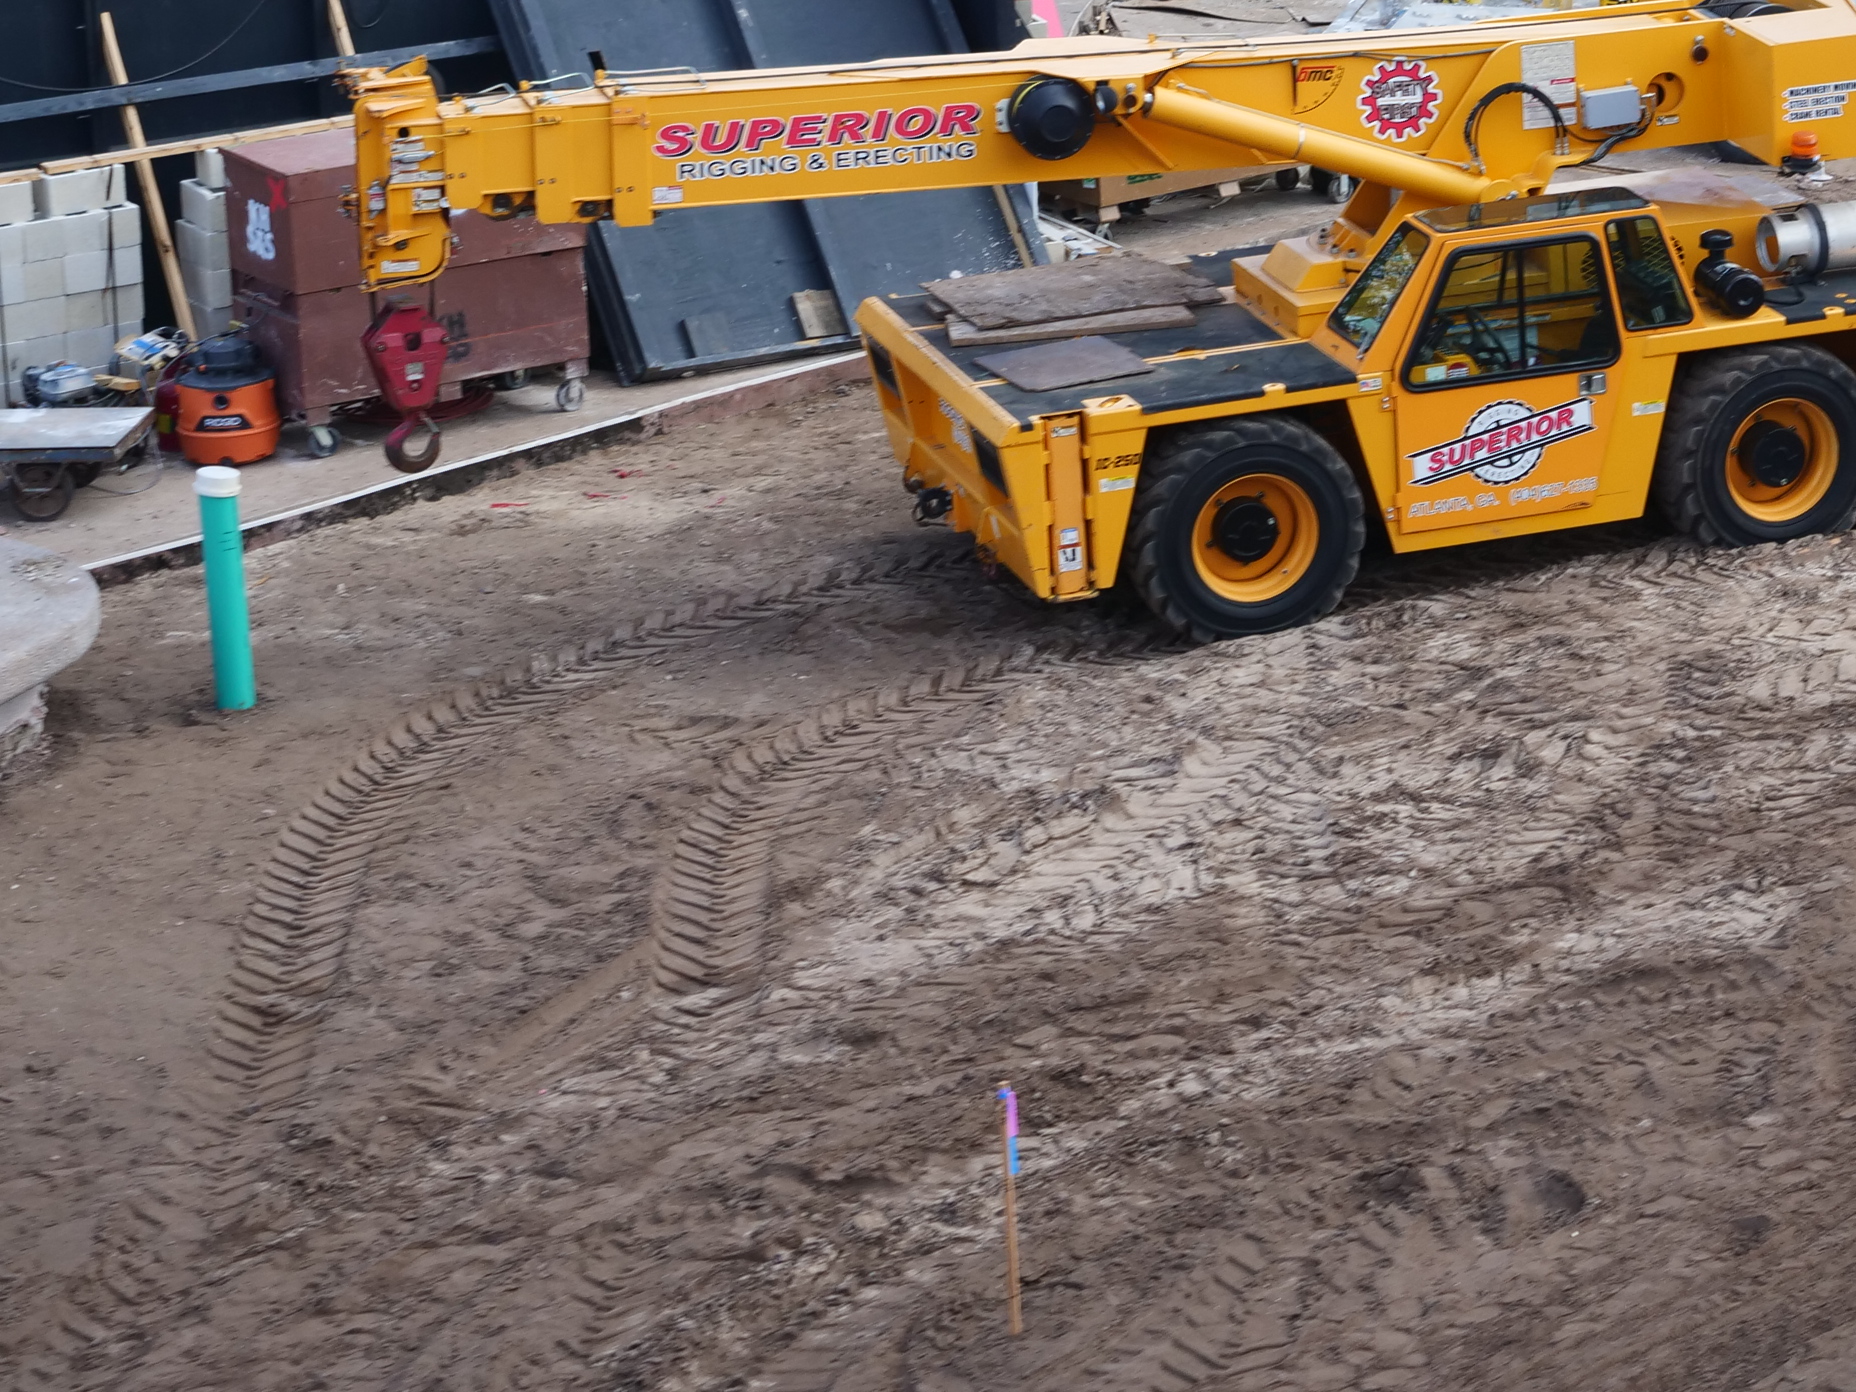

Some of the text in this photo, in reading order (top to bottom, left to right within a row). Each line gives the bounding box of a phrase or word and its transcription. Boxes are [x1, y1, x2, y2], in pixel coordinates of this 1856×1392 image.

[1371, 78, 1430, 99] SAFETY
[1378, 102, 1424, 121] FIRST
[651, 102, 982, 158] SUPERIOR
[676, 140, 979, 182] RIGGING & ERECTING
[1427, 407, 1575, 474] SUPERIOR
[1094, 452, 1142, 471] IC-250
[1408, 495, 1474, 518] ATLANTA,
